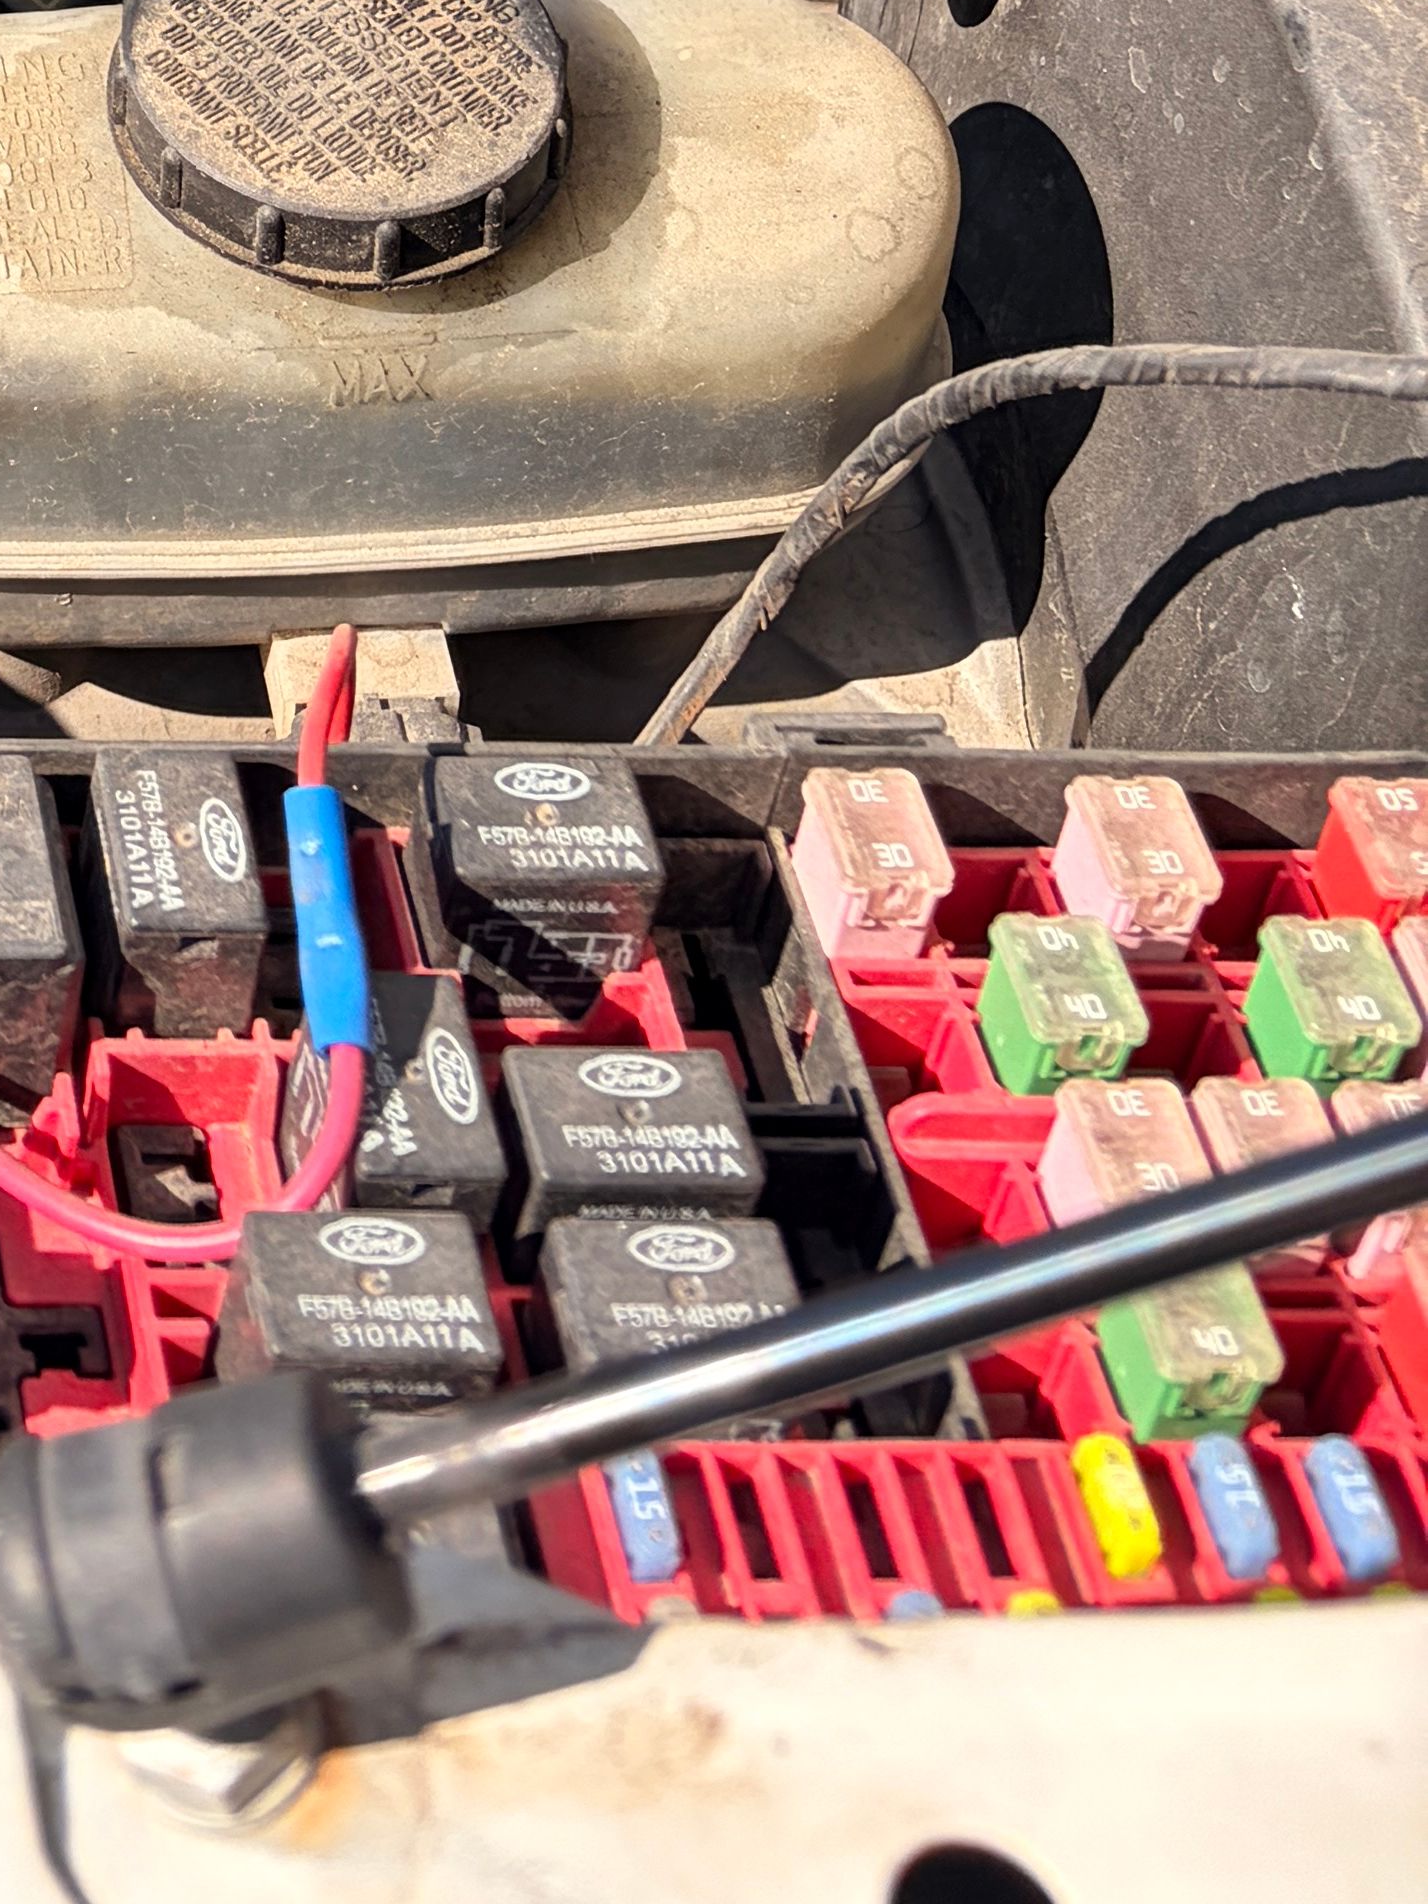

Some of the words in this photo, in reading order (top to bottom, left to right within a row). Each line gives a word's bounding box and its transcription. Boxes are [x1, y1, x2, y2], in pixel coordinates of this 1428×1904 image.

[249, 20, 313, 64] AVANT
[301, 60, 336, 89] DE
[324, 83, 360, 113] LE
[297, 17, 374, 82] BOUCHON
[365, 78, 400, 108] DE
[472, 25, 542, 80] BEFORE
[161, 23, 204, 55] DOT
[194, 52, 219, 70] 3
[208, 64, 304, 142] PROVENANT
[430, 22, 475, 54] DOT
[461, 54, 487, 69] 3
[476, 67, 539, 115] BRAKE
[145, 48, 237, 125] CONTENANT
[257, 63, 299, 98] QUE
[286, 92, 323, 121] DU
[312, 116, 386, 182] LIQUIDE
[329, 354, 434, 407] MAX
[846, 779, 889, 803] 30
[1113, 785, 1157, 809] 30
[115, 790, 155, 909] 3101A11A
[136, 769, 186, 911] F57B-14B192-AA
[477, 825, 645, 848] F57B-14B192-AA
[508, 848, 650, 873] 3101A11A
[871, 842, 915, 868] 30
[1142, 849, 1184, 875] 30
[1036, 925, 1080, 951] 40
[1306, 927, 1351, 953] 40
[1062, 993, 1108, 1020] 40
[1337, 994, 1382, 1021] 40
[1107, 1090, 1152, 1116] 30
[1241, 1090, 1285, 1117] 30
[561, 1123, 741, 1150] F57B-14B192-AA
[597, 1149, 747, 1178] 3101A11A
[1133, 1162, 1180, 1191] 30
[297, 1293, 482, 1323] F57B-14B192-AA
[331, 1322, 486, 1353] 3101A11A
[1191, 1325, 1240, 1357] 40
[625, 1476, 668, 1521] 15
